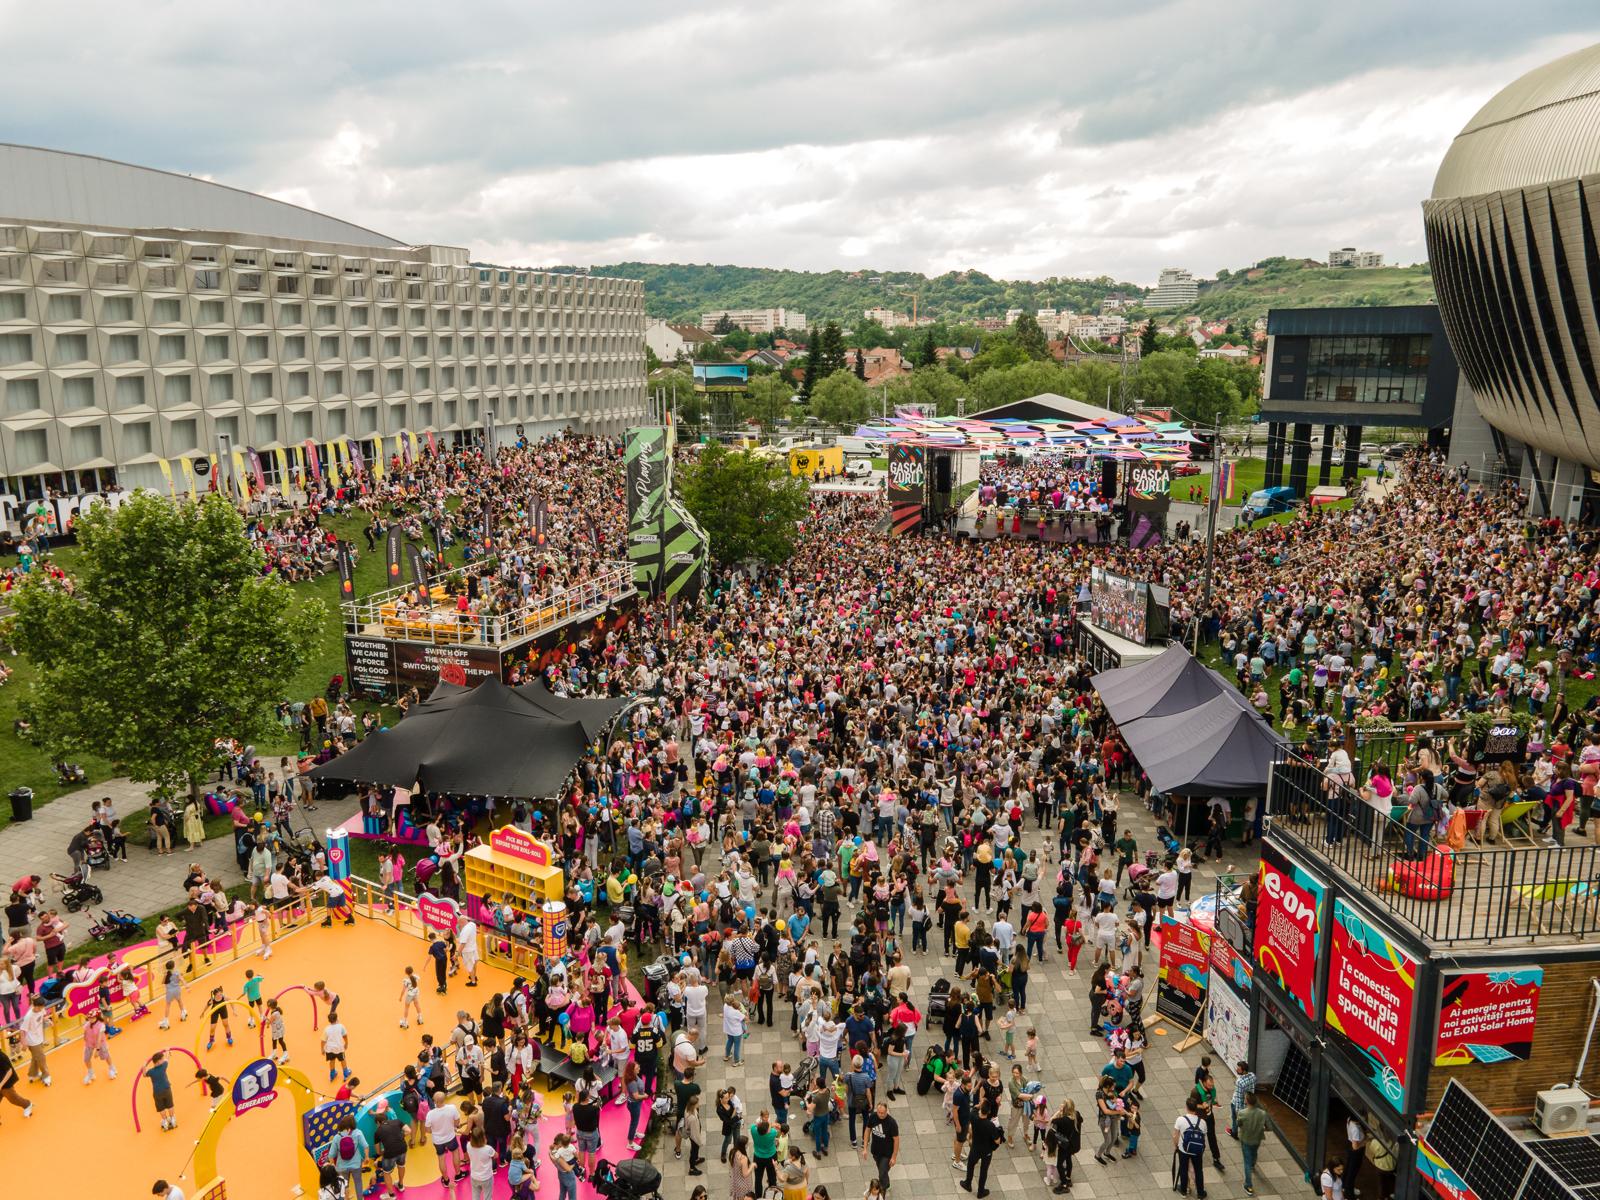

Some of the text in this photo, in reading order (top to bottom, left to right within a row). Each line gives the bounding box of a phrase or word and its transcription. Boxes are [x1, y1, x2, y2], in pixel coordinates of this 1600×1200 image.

[890, 462, 924, 474] GASCA
[1133, 468, 1170, 482] GASCA
[893, 472, 923, 484] ZURLI
[1136, 480, 1166, 492] ZURLI
[351, 640, 388, 650] TOGETHER,
[403, 663, 430, 671] SWITCH
[440, 910, 453, 919] GOOD
[440, 918, 451, 927] ROLL
[1342, 956, 1400, 1007] Te conectăm
[78, 997, 95, 1009] WITH
[1340, 970, 1398, 1026] la energia
[1450, 998, 1531, 1018] Ai energie pentru
[1338, 994, 1396, 1045] sportului!
[1444, 1018, 1458, 1028] noi
[1504, 1006, 1533, 1017] acasă,
[1440, 1016, 1534, 1038] cu E.ON Solar Home
[638, 1039, 653, 1052] 95
[241, 1064, 272, 1100] BT
[237, 1093, 275, 1111] GENERATION
[1437, 1169, 1458, 1198] Casă
